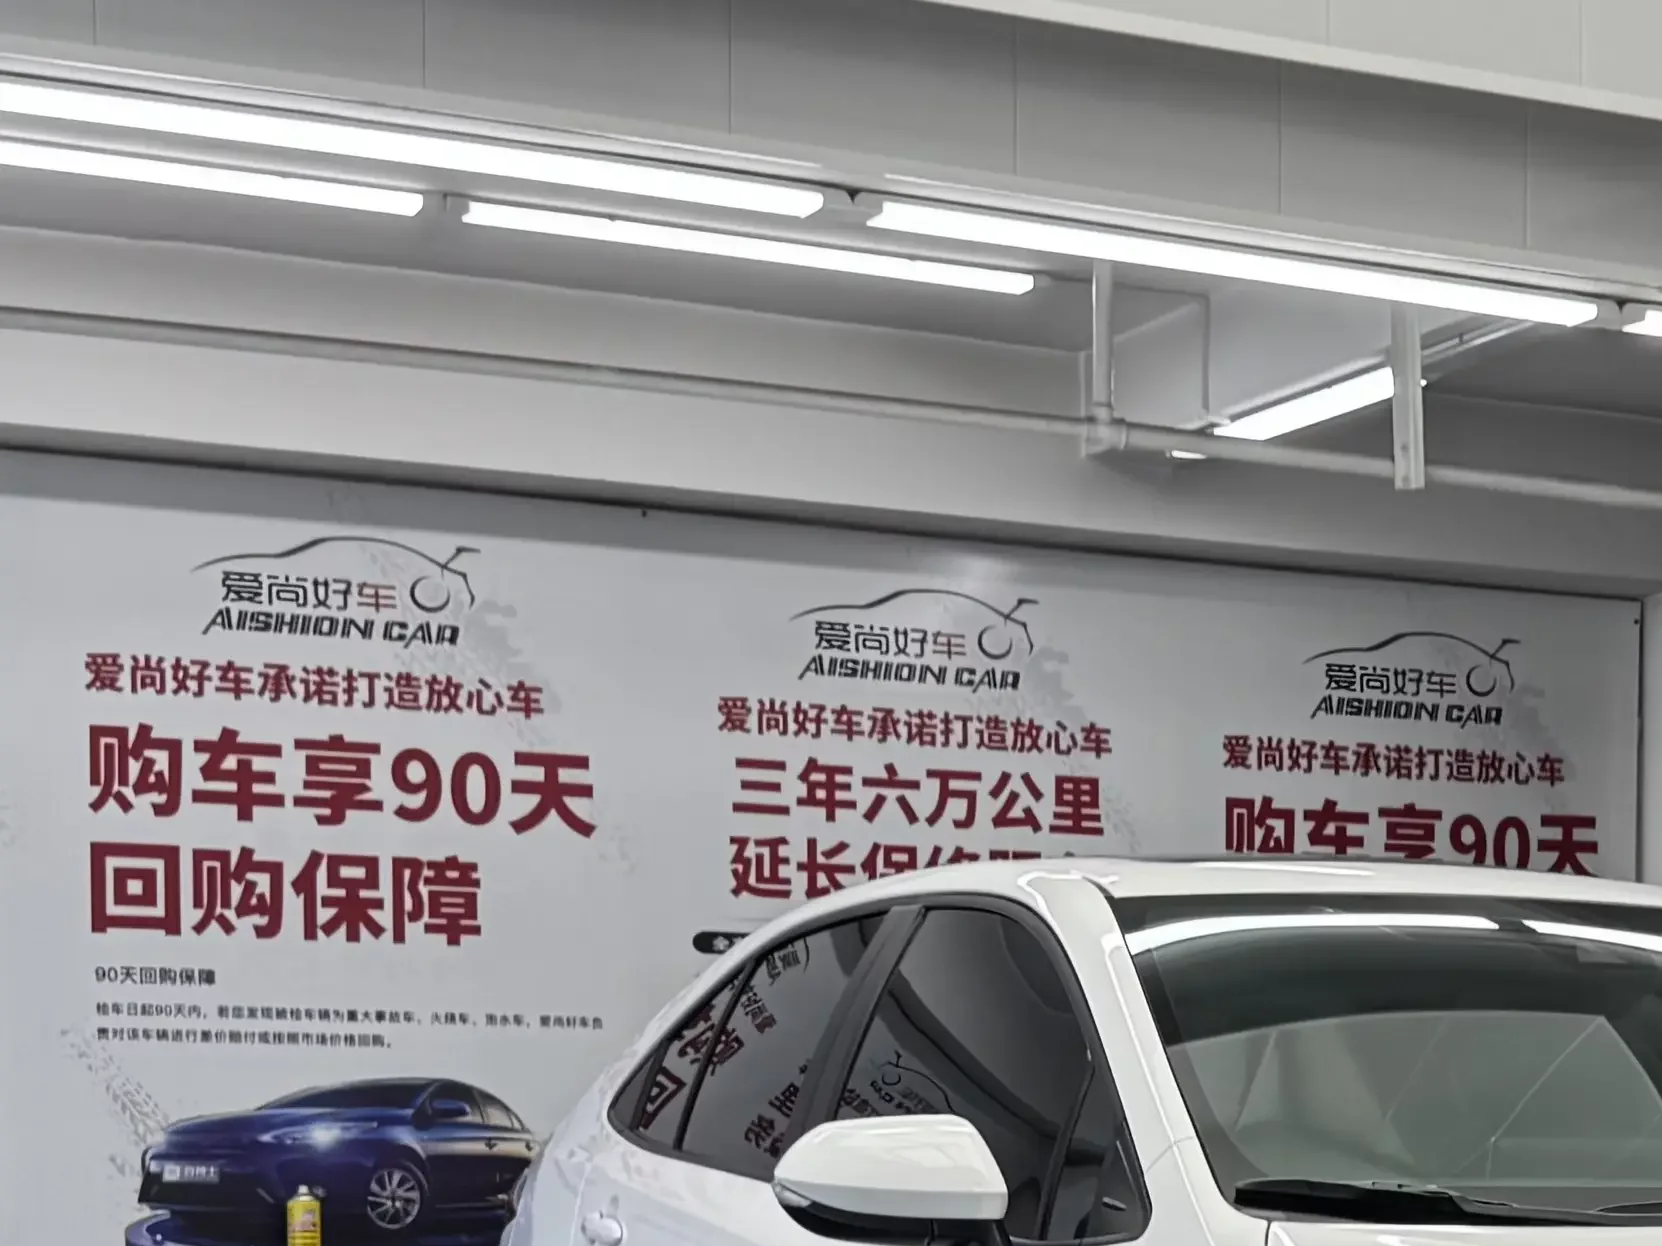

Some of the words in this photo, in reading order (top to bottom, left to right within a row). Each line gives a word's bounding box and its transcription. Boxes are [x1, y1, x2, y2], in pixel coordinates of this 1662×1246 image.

[221, 571, 397, 614] 爱尚好车
[202, 606, 375, 640] AISHION
[382, 617, 460, 648] CAR
[814, 620, 966, 660] 爱尚好车
[84, 652, 546, 720] 爱尚好车承诺打造放心车
[798, 655, 947, 686] AISHION
[954, 665, 1021, 693] CAR
[1325, 663, 1457, 697] 爱尚好车
[717, 696, 1113, 759] 爱尚好车承诺打造放心车
[1311, 695, 1438, 722] AISHION
[1445, 704, 1503, 730] CAR
[88, 722, 597, 839] 购车享90天
[1222, 734, 1565, 787] 爱尚好车承诺打造放心车
[732, 756, 1105, 837] 三年六万公里
[1225, 796, 1600, 877] 购车享90天
[89, 841, 482, 947] 回购保障
[729, 836, 1082, 900] 延长保
[95, 965, 217, 987] 90天回购保障
